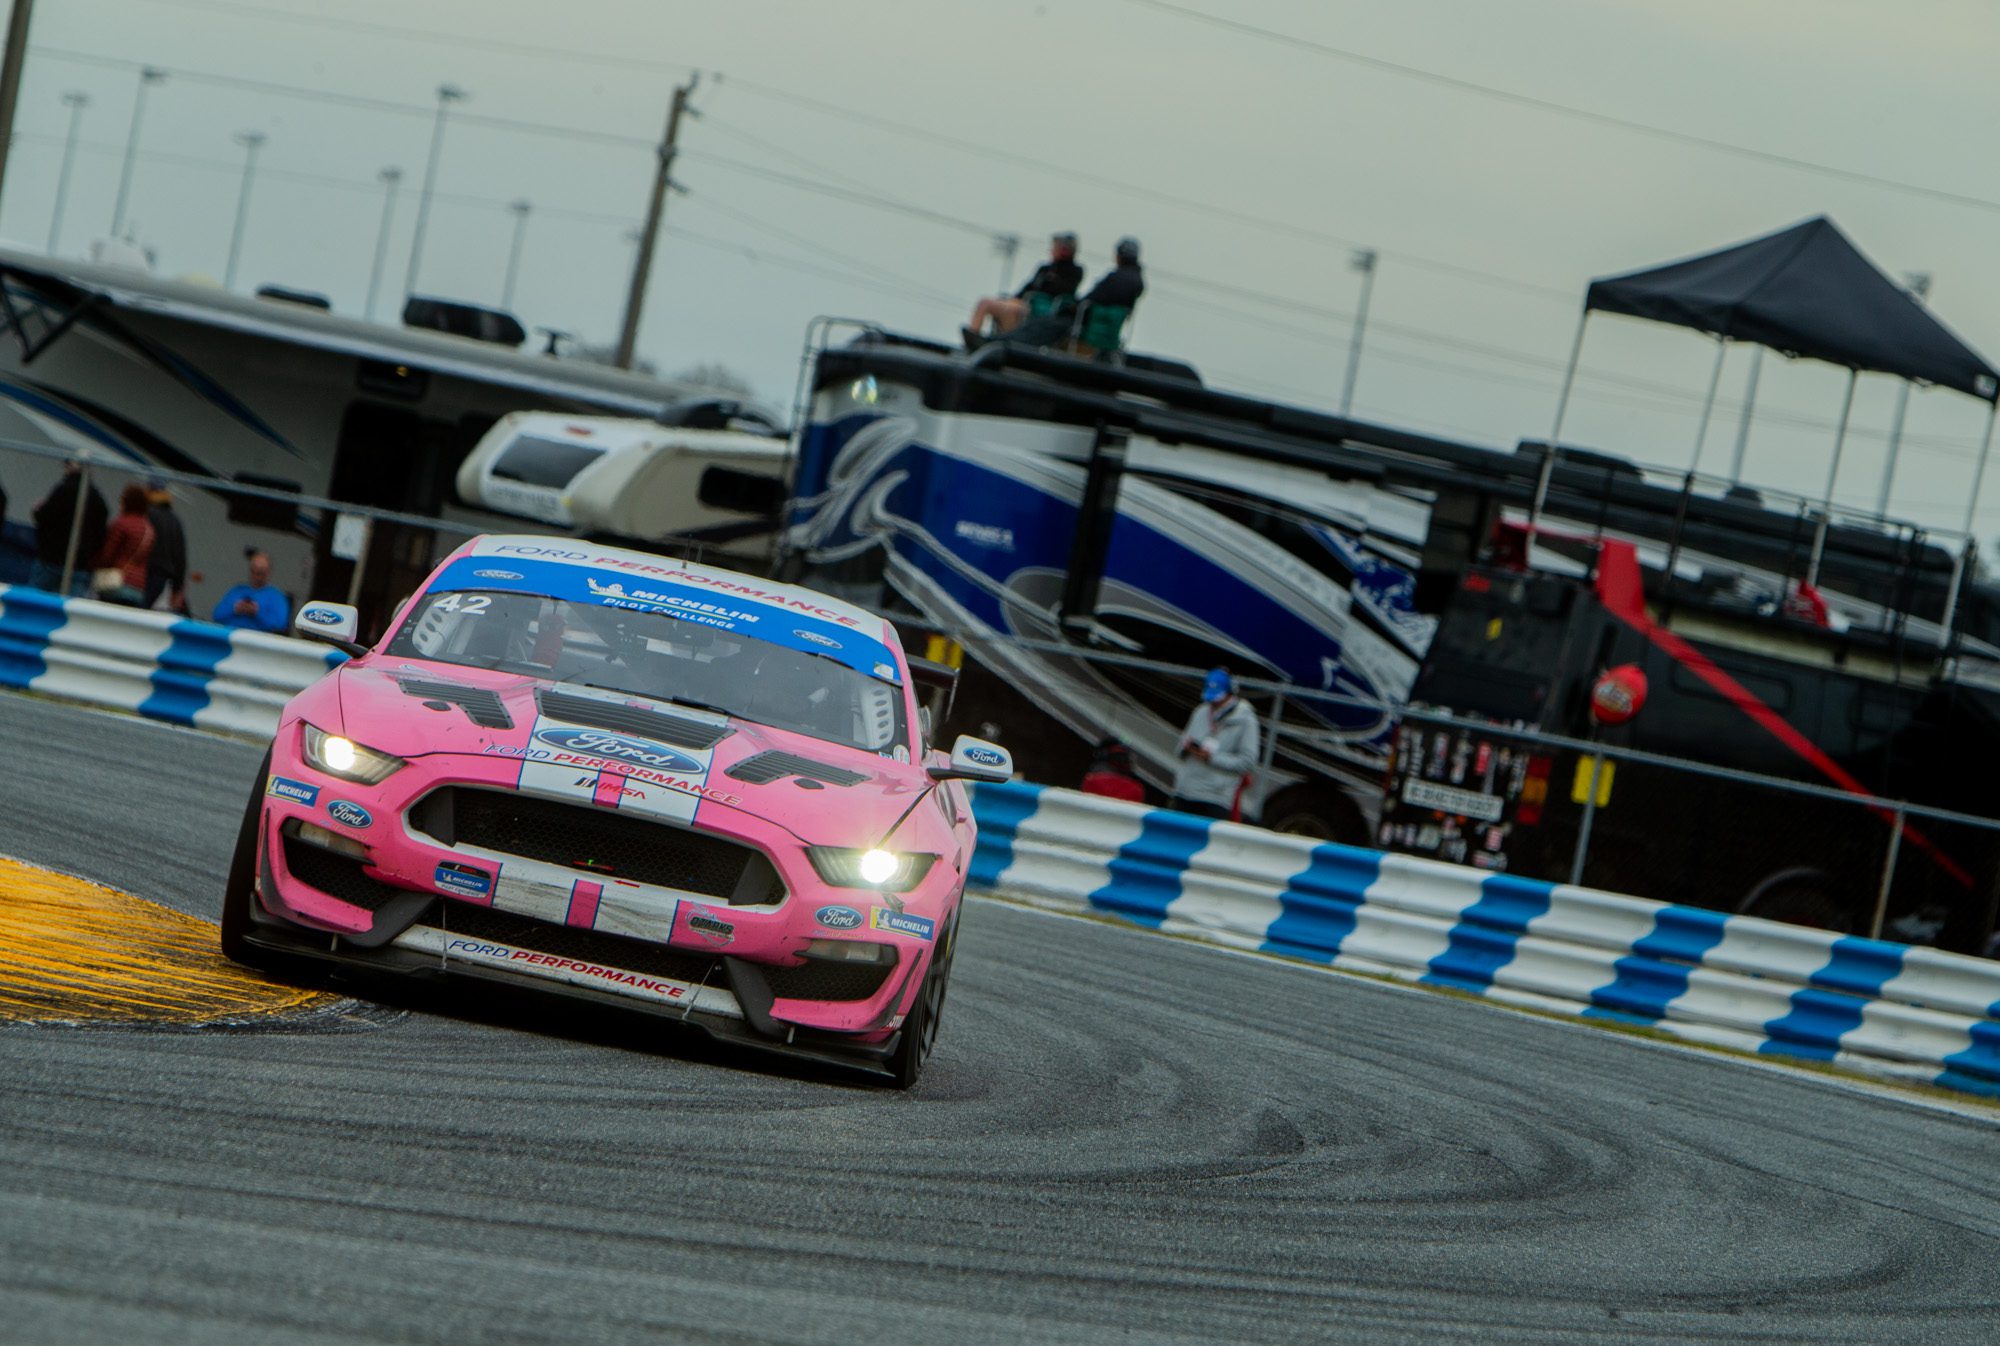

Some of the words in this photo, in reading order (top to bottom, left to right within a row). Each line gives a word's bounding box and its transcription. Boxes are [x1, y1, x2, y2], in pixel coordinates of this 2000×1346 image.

[495, 545, 588, 560] FORD
[593, 557, 861, 627] PERFORMANCE
[433, 593, 492, 615] 42
[603, 597, 647, 611] PILOT
[650, 605, 735, 629] CHALLENGE
[632, 589, 760, 623] MICHELIN
[565, 730, 675, 767] Ford
[971, 749, 999, 765] Ford
[484, 744, 550, 759] FORD
[553, 753, 743, 805] PERFORMANCE
[277, 783, 313, 800] MICHELIN
[332, 802, 365, 826] Ford
[823, 909, 855, 927] Ford
[891, 918, 930, 934] MICHELIN
[448, 940, 509, 957] FORD
[510, 951, 686, 998] PERFORMANCE
